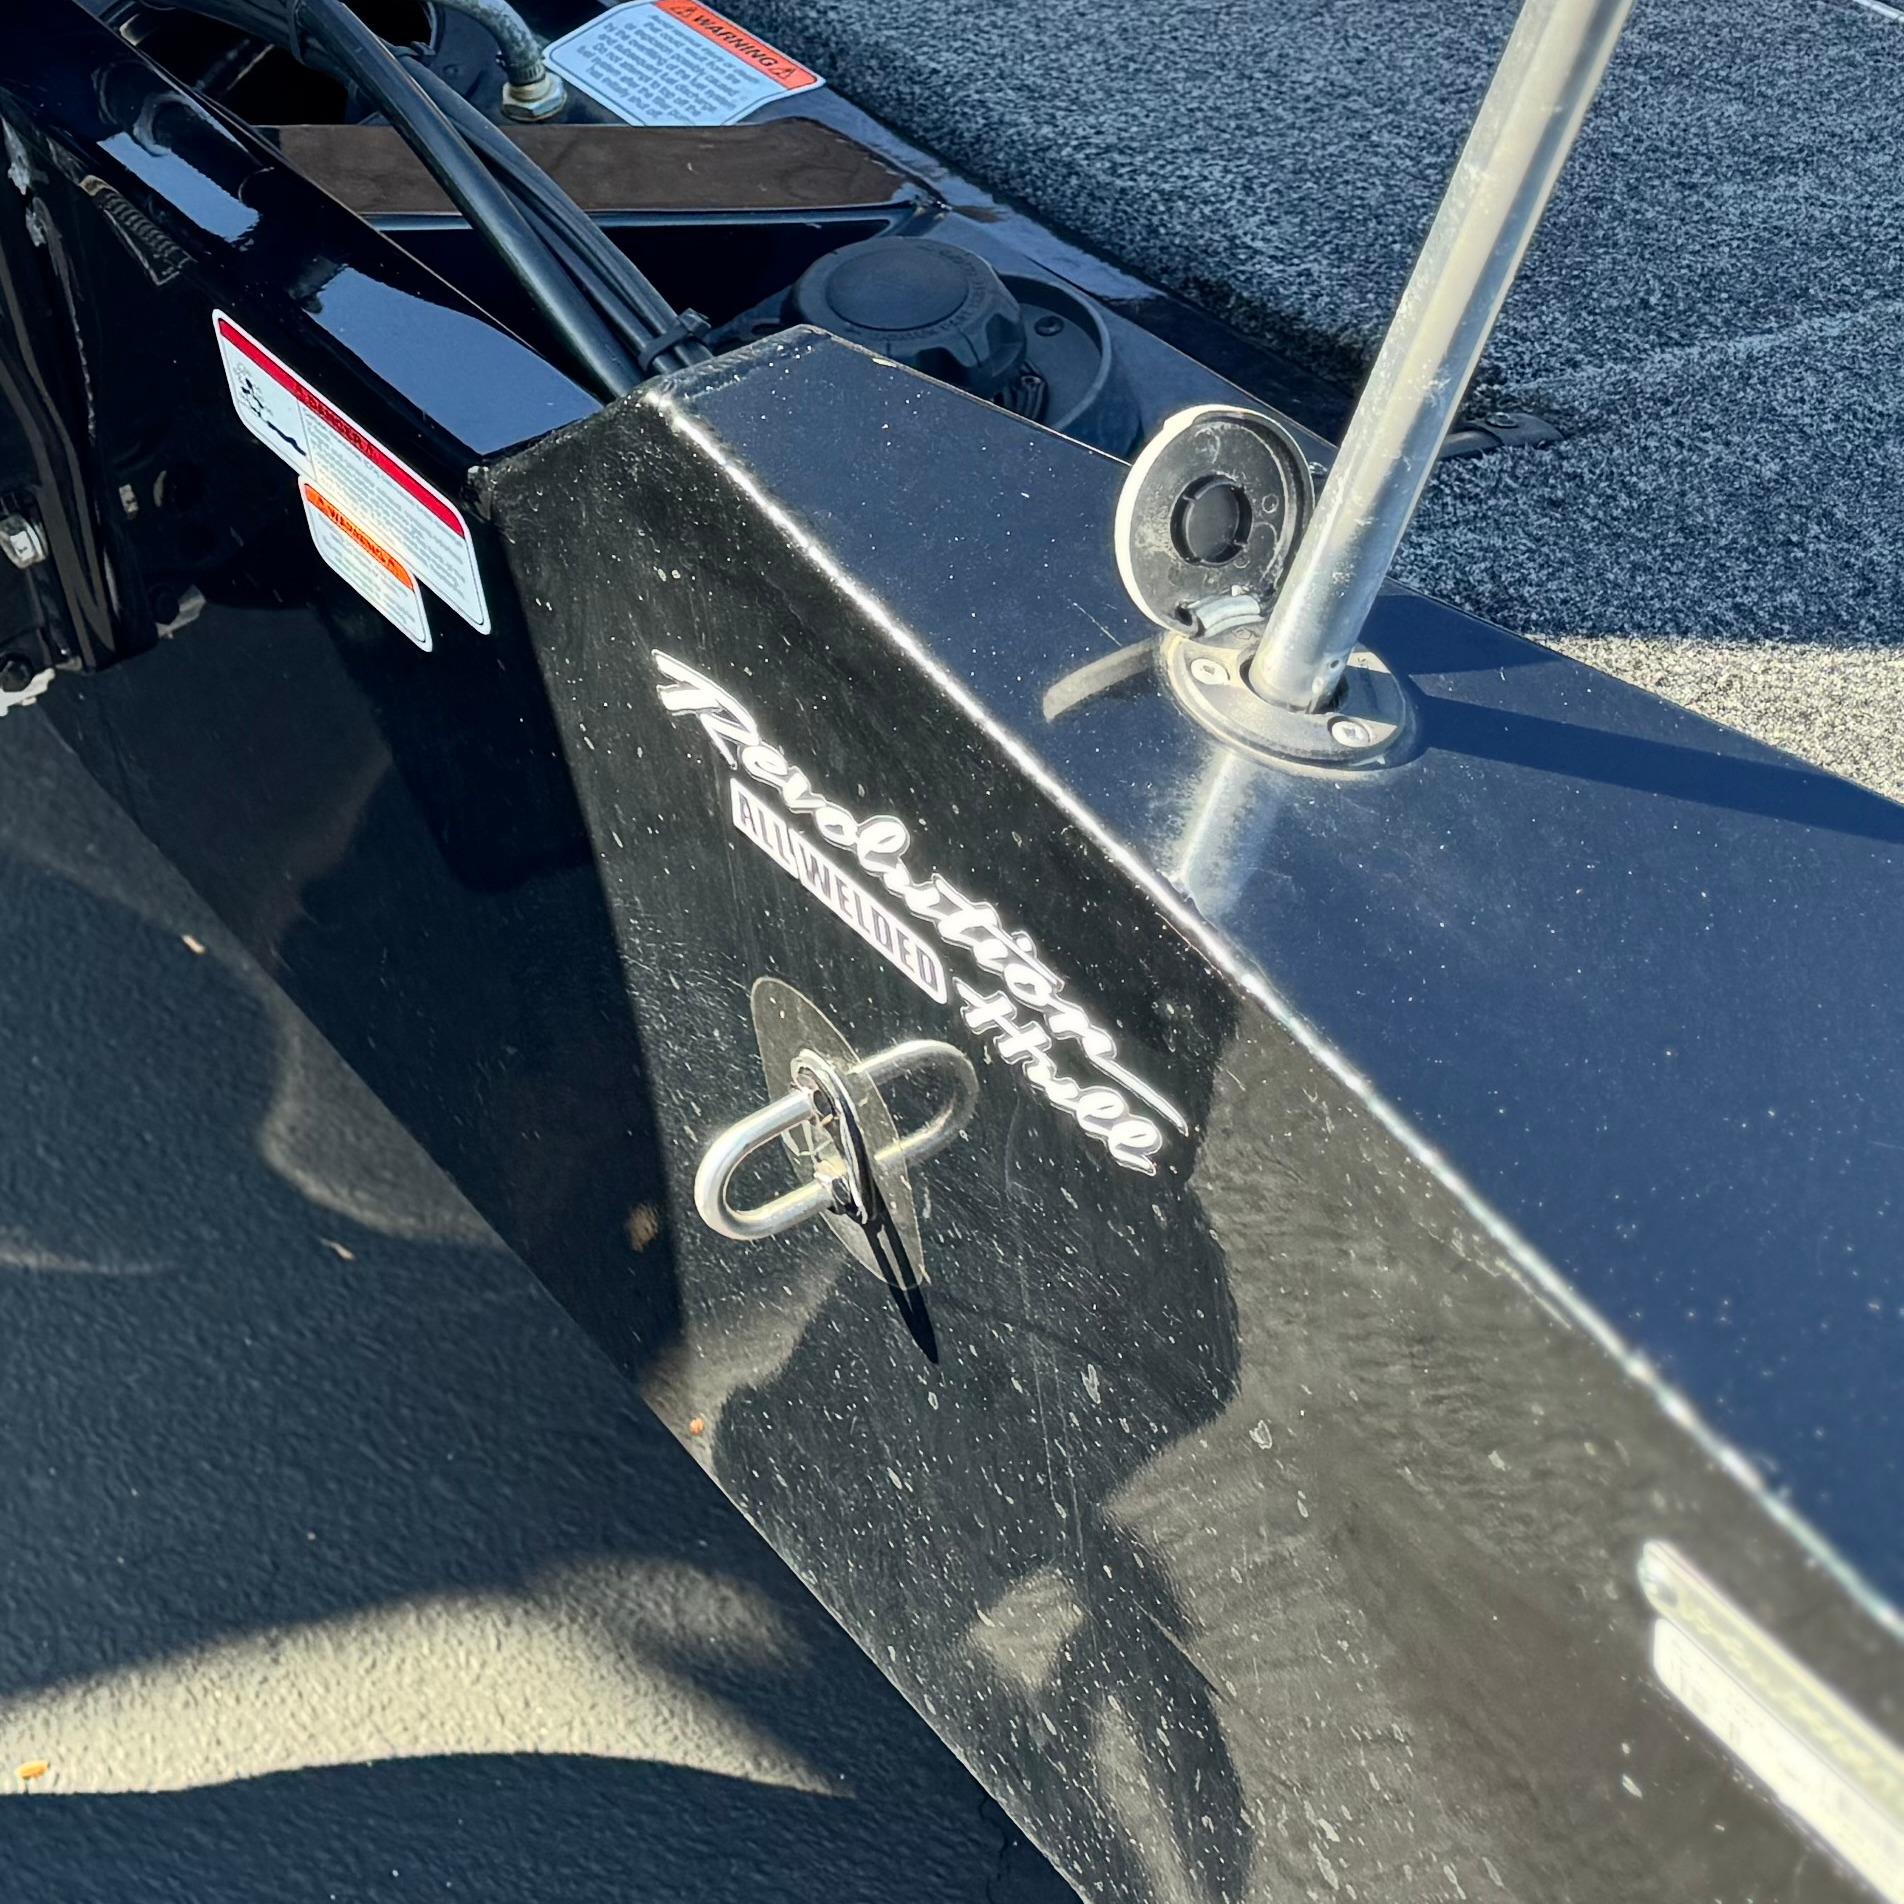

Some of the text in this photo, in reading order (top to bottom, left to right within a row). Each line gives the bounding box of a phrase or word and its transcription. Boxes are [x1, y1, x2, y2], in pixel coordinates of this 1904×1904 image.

[693, 14, 778, 68] WARNING
[652, 648, 1189, 1136] Revolution
[740, 798, 941, 991] ALL WELDED
[954, 978, 1162, 1176] Hull
